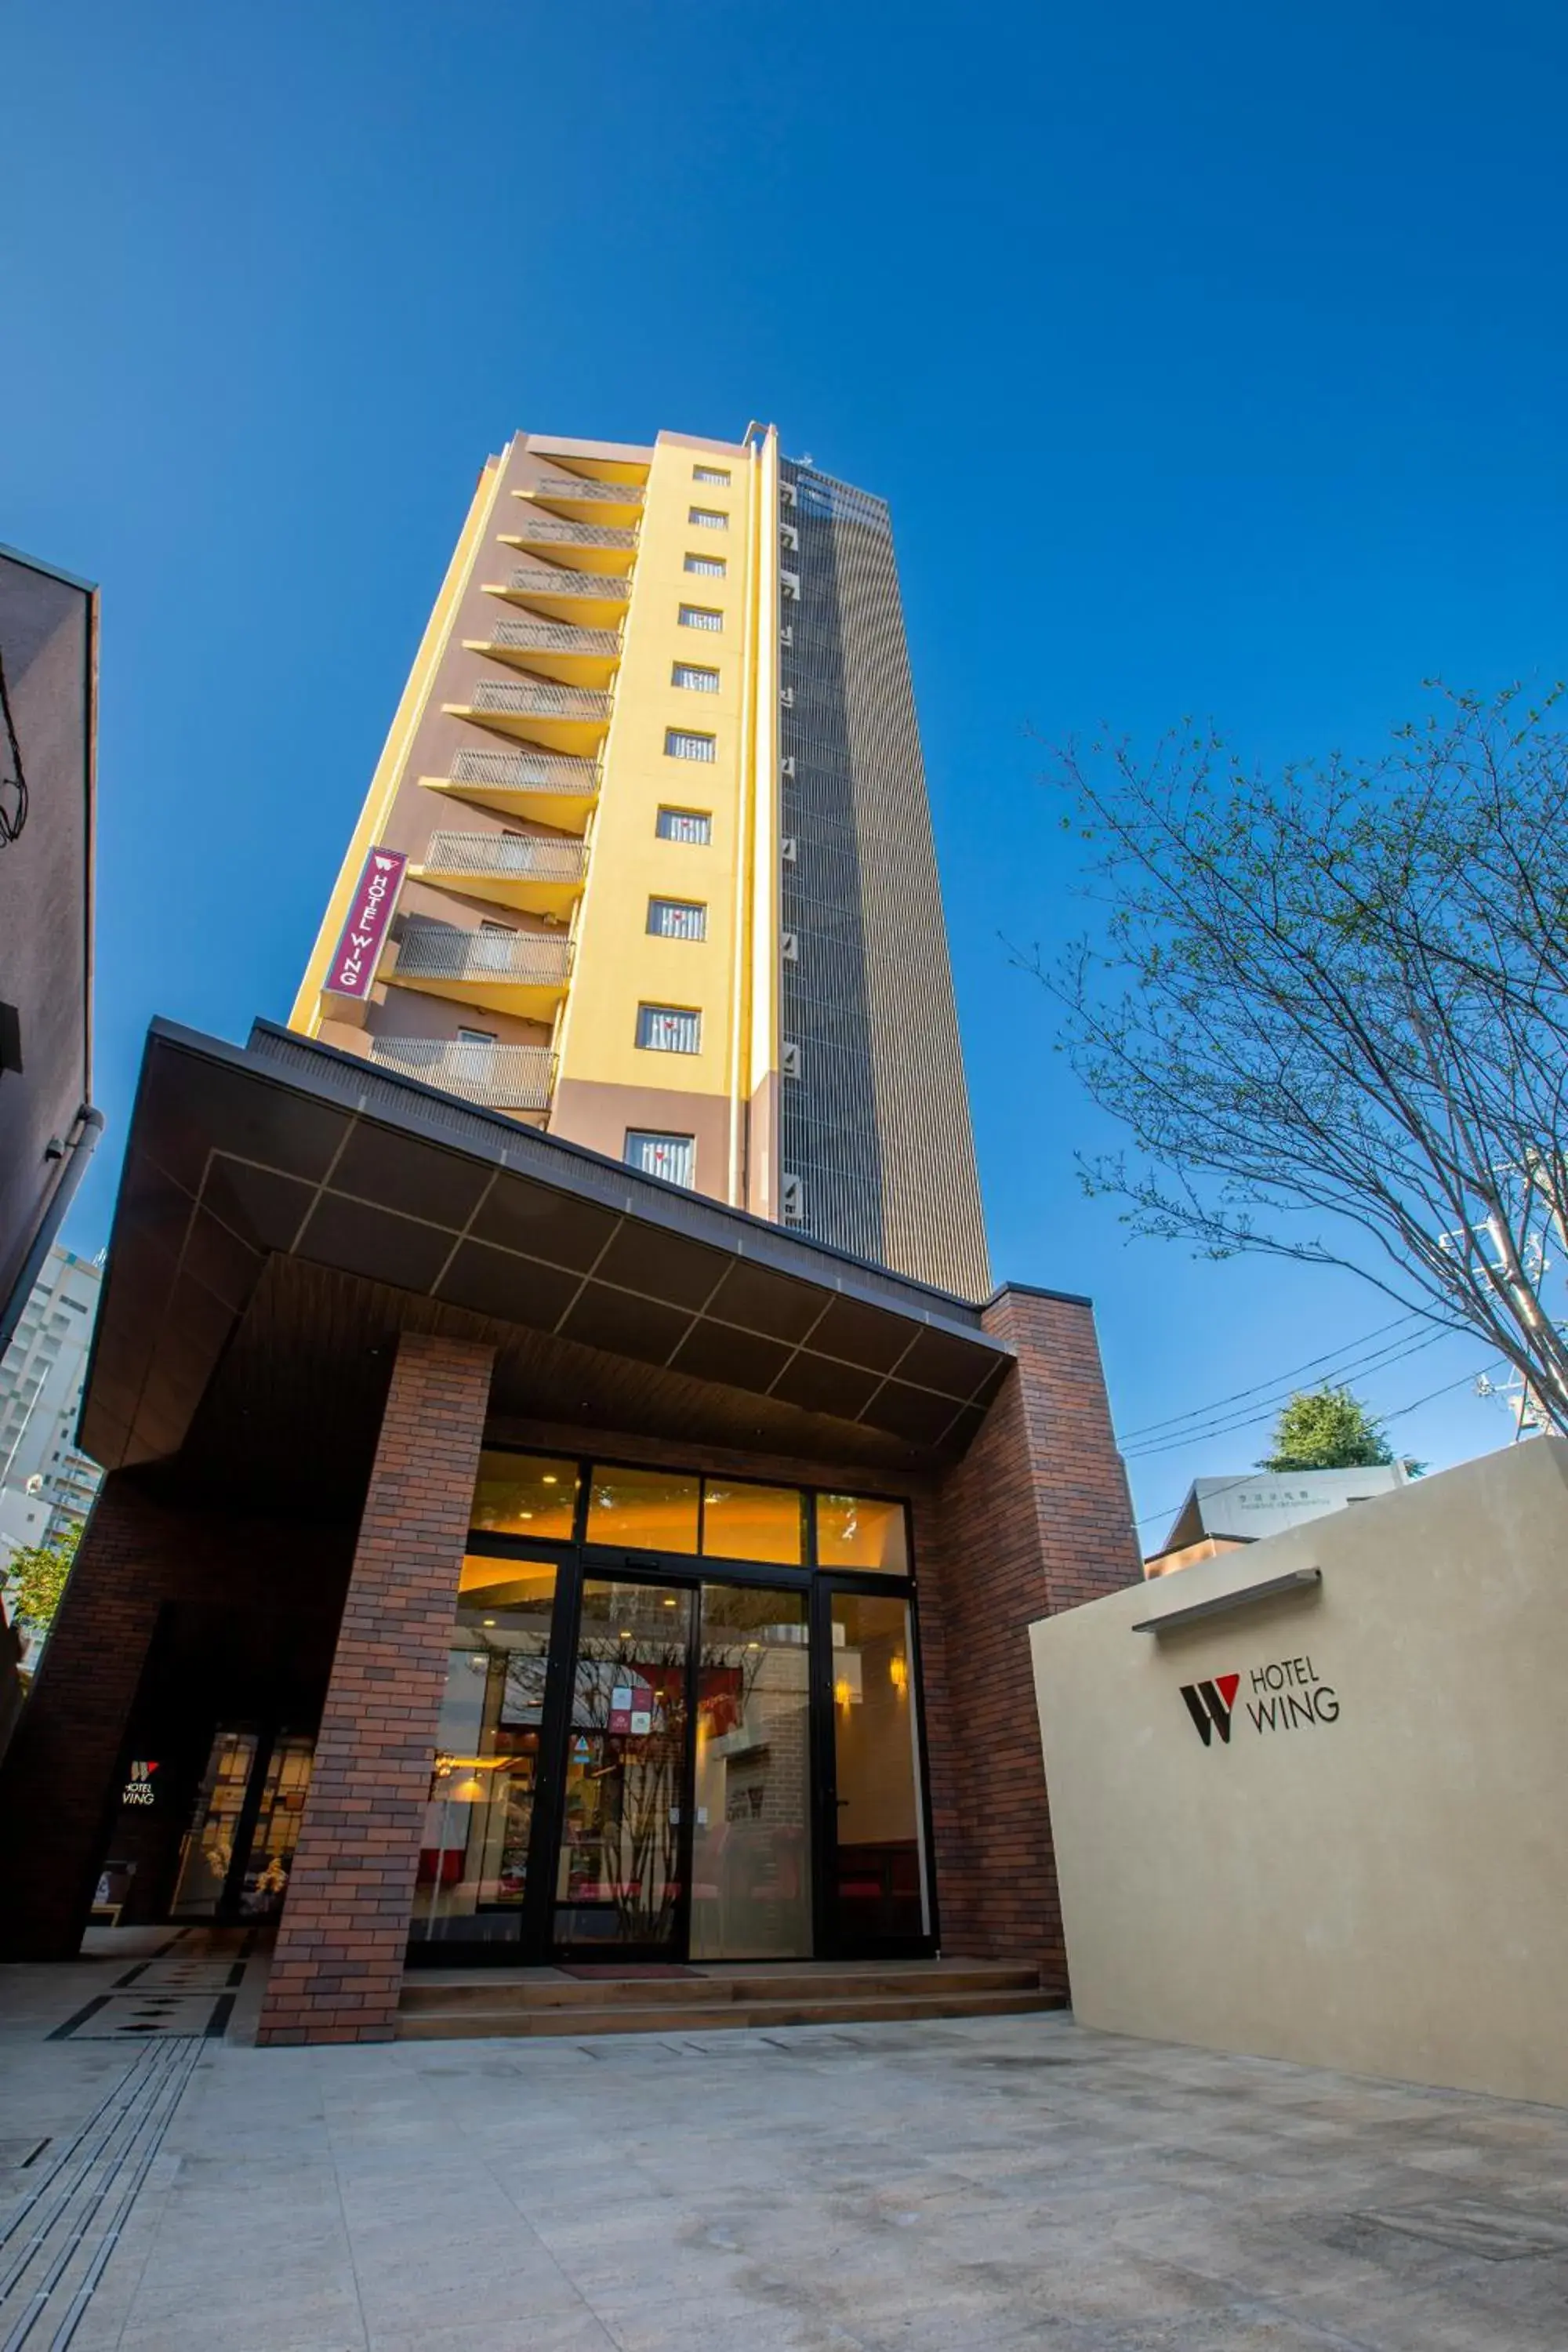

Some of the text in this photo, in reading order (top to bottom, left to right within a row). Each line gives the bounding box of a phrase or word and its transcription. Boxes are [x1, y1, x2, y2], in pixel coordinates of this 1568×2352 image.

[340, 874, 387, 985] HOTEL WING
[1250, 1656, 1319, 1694] HOTEL
[1246, 1686, 1340, 1735] WING
